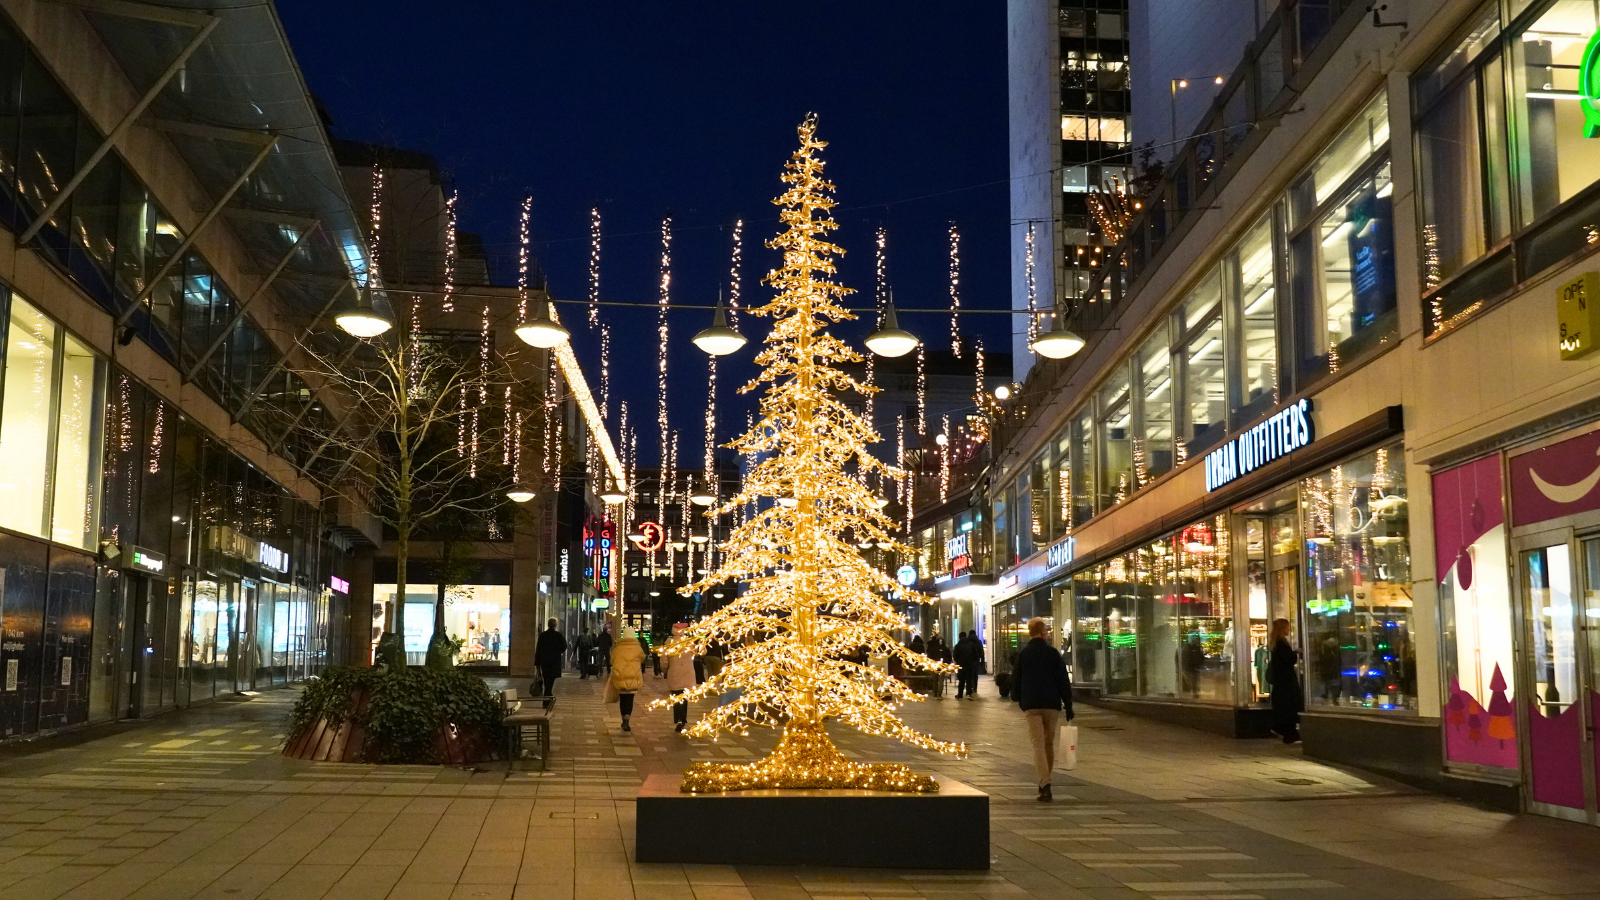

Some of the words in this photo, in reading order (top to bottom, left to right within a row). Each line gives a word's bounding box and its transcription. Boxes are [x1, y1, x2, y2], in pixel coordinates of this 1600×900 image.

[1205, 440, 1236, 492] URBAN
[1239, 398, 1308, 474] OUTFITTERS
[559, 548, 568, 583] newbie
[601, 529, 610, 577] GODIS
[947, 533, 967, 559] SERGEL
